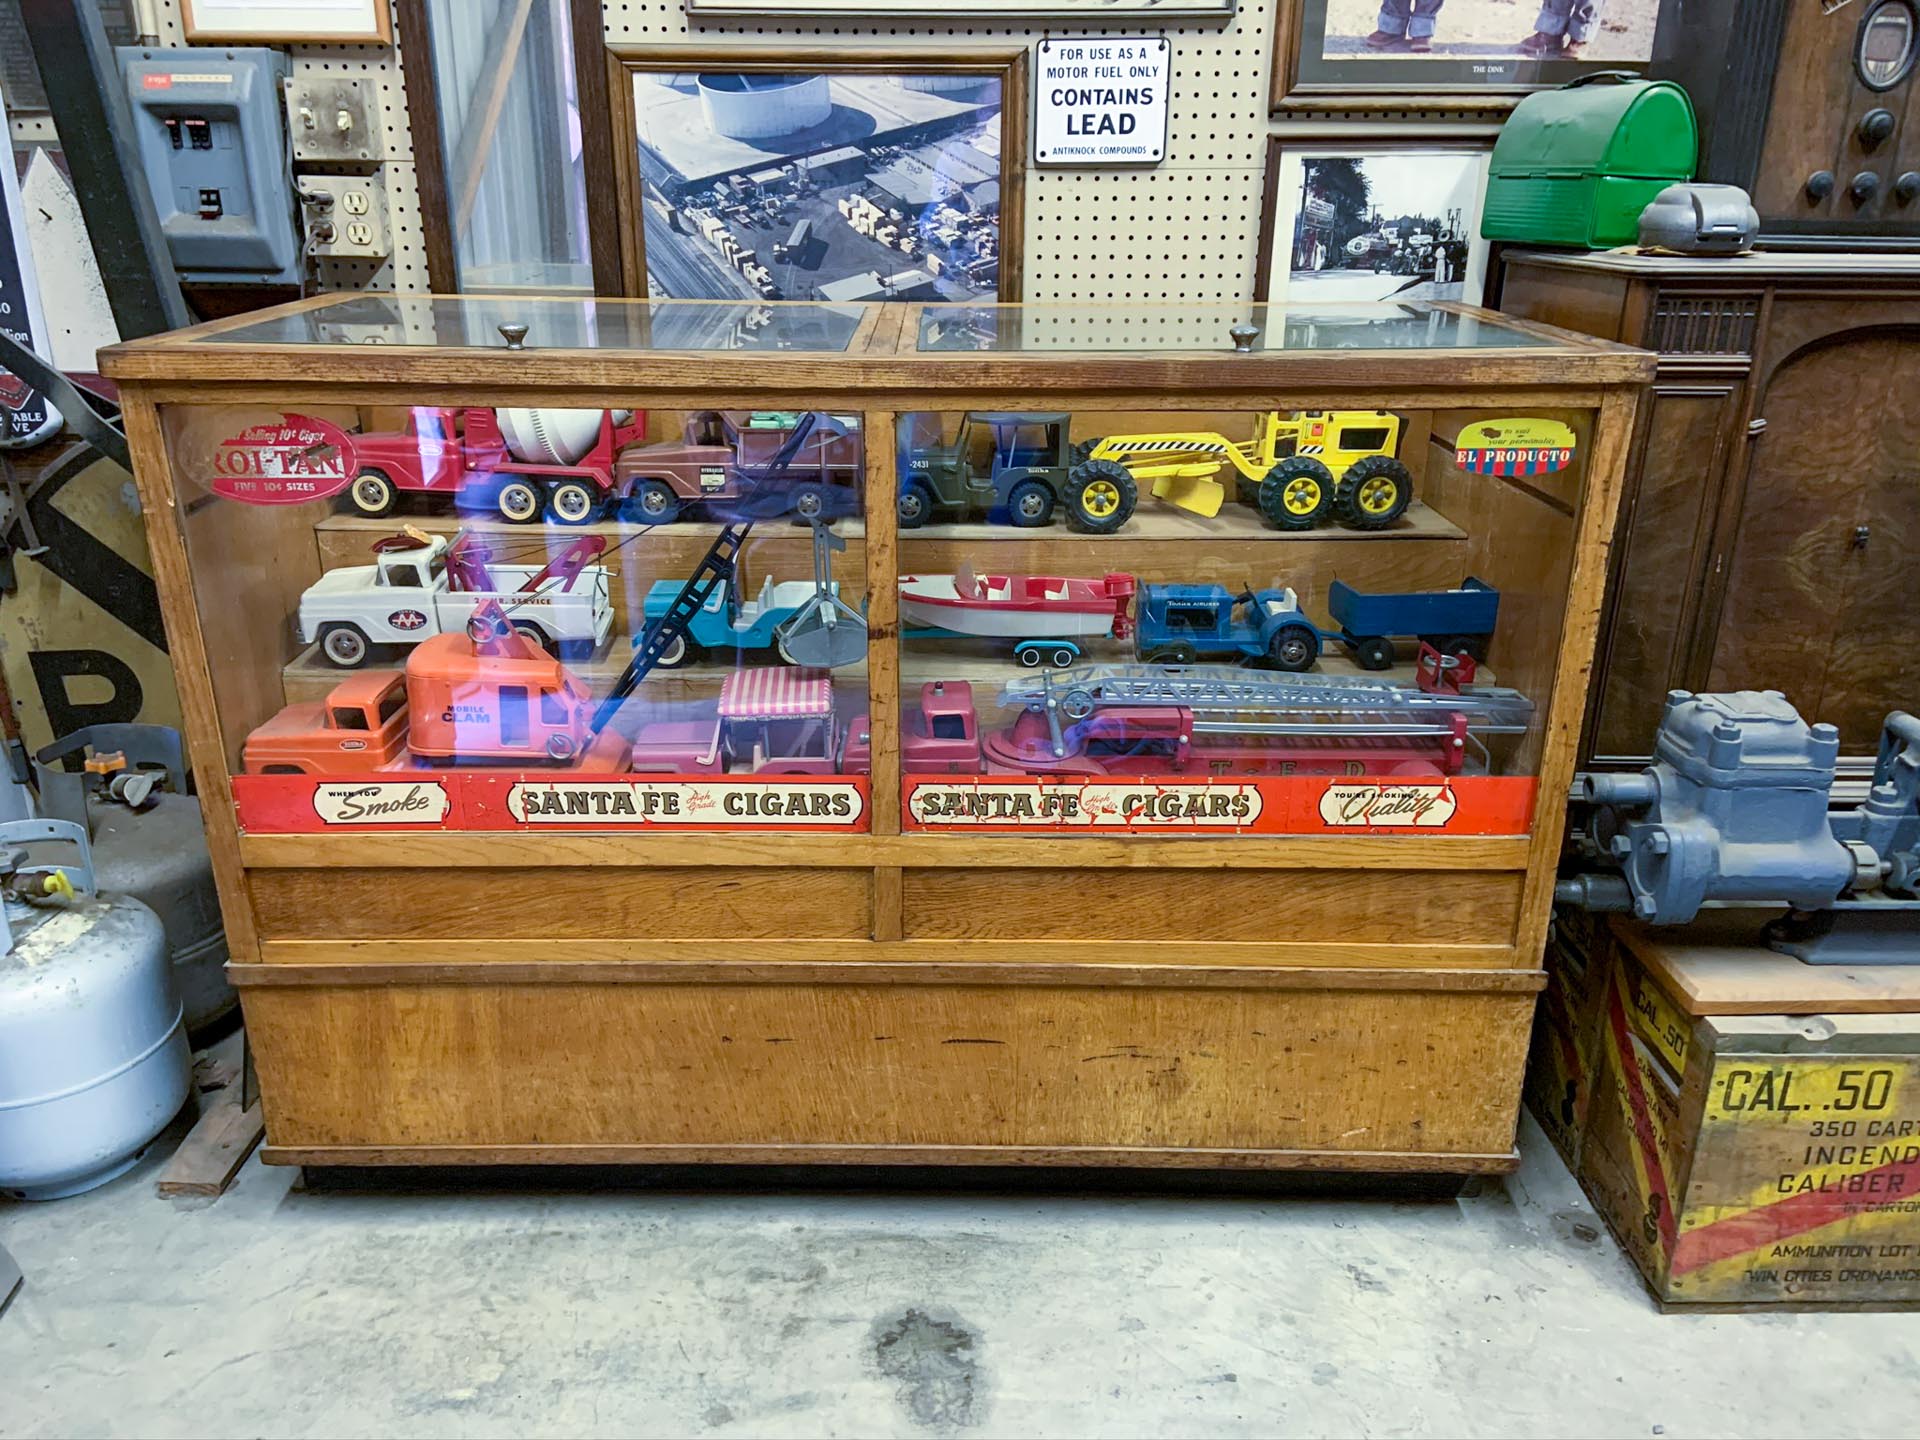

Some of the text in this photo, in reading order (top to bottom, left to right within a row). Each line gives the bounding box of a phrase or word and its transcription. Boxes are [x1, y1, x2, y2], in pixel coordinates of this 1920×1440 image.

[1060, 47, 1147, 60] FOR USE AS A
[1047, 66, 1159, 78] MOTOR FUEL ONLY
[1051, 88, 1153, 106] CONTAINS
[1067, 113, 1136, 135] LEAD
[1052, 146, 1147, 155] ANTIKNOCK COMPOUNDS
[1456, 449, 1570, 463] EL PRODUCTO
[286, 482, 316, 491] SIZES
[442, 712, 490, 723] CLAM
[447, 705, 485, 713] MOBILE
[337, 785, 430, 820] Smoke
[522, 791, 680, 816] SANTA FE
[723, 791, 852, 816] CIGARS
[922, 793, 1078, 817] SANTA FE
[1122, 793, 1250, 817] CIGARS
[1342, 788, 1436, 822] Quality
[1722, 1070, 1894, 1111] CAL. .50
[1809, 1121, 1857, 1137] 350
[1803, 1146, 1920, 1166] INCEND
[1777, 1174, 1905, 1193] CALIBER
[1771, 1245, 1873, 1258] AMMUNITION
[1879, 1244, 1912, 1258] LOT
[1784, 1269, 1832, 1283] CITIES
